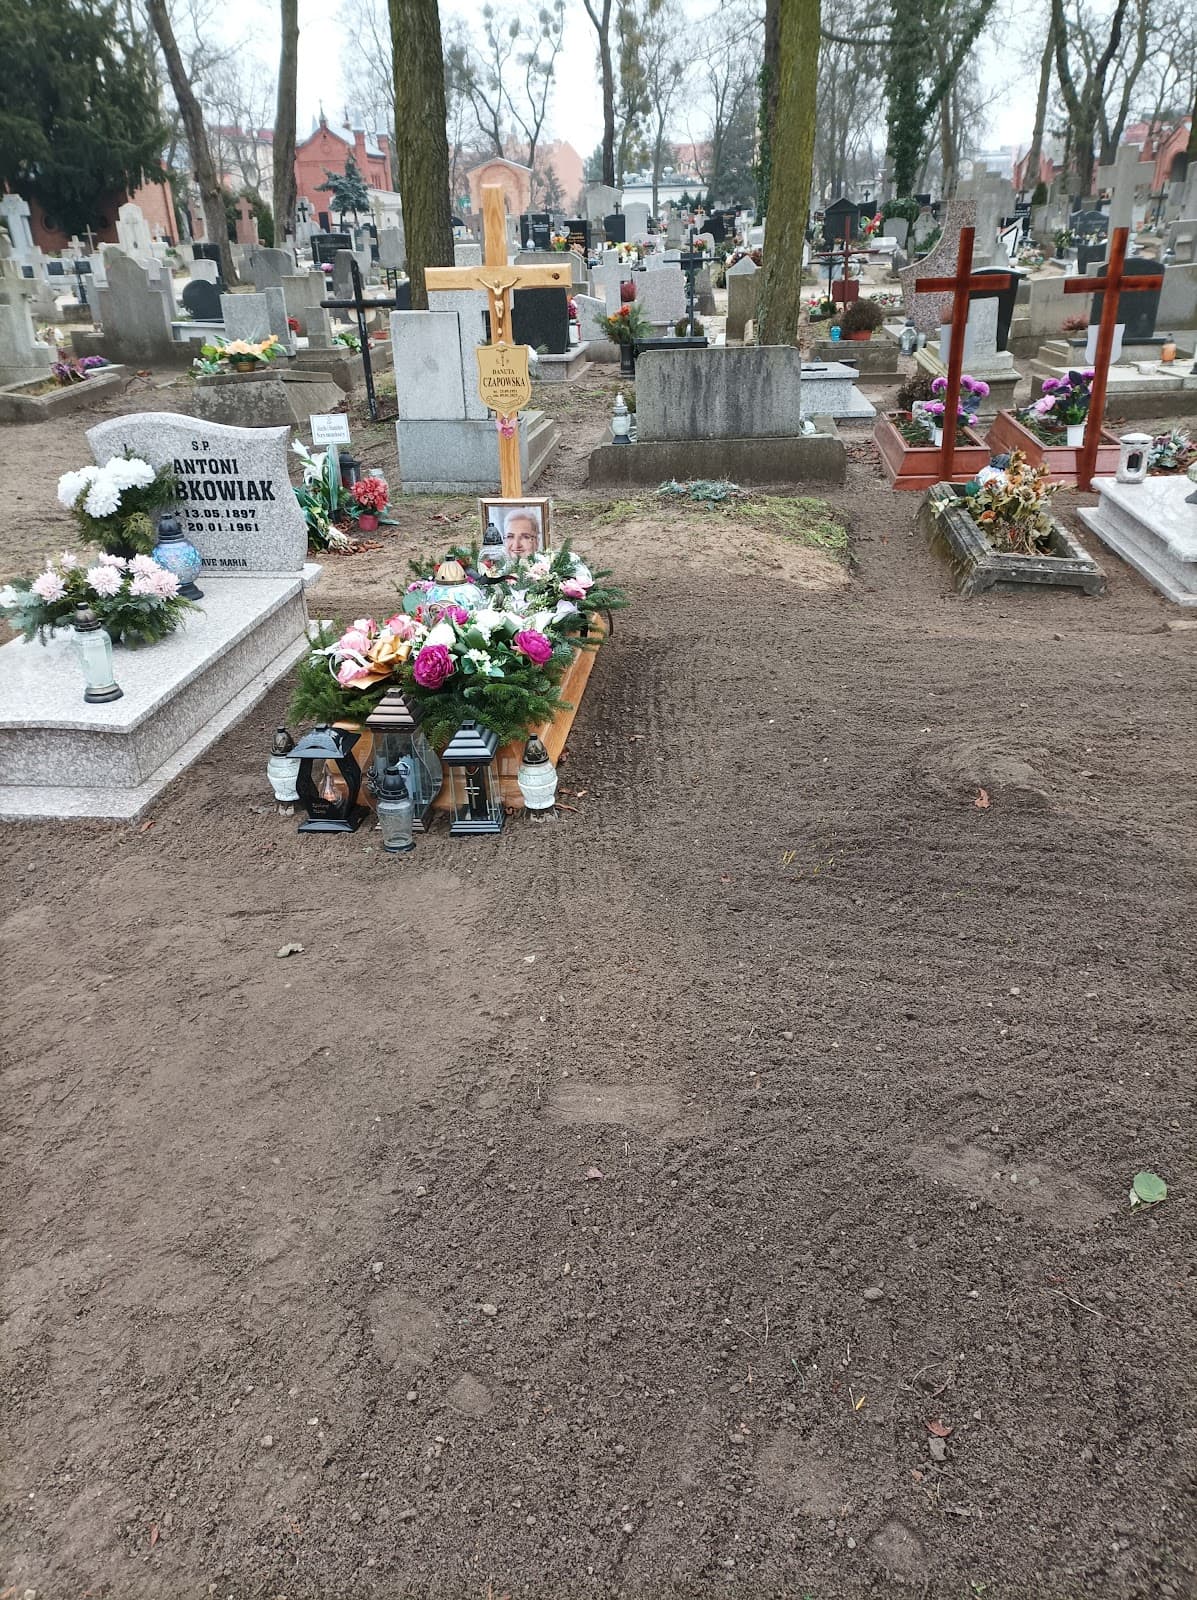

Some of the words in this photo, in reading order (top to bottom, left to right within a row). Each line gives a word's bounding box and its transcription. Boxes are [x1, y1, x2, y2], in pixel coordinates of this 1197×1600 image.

[483, 377, 525, 387] CZAPOWSKA
[173, 458, 239, 475] ANTONI
[172, 480, 276, 501] BKOWIAK
[184, 509, 256, 519] 13.05.1897
[187, 522, 260, 532] 20.01.1961
[201, 558, 218, 567] AVE
[219, 558, 248, 567] MARIA
